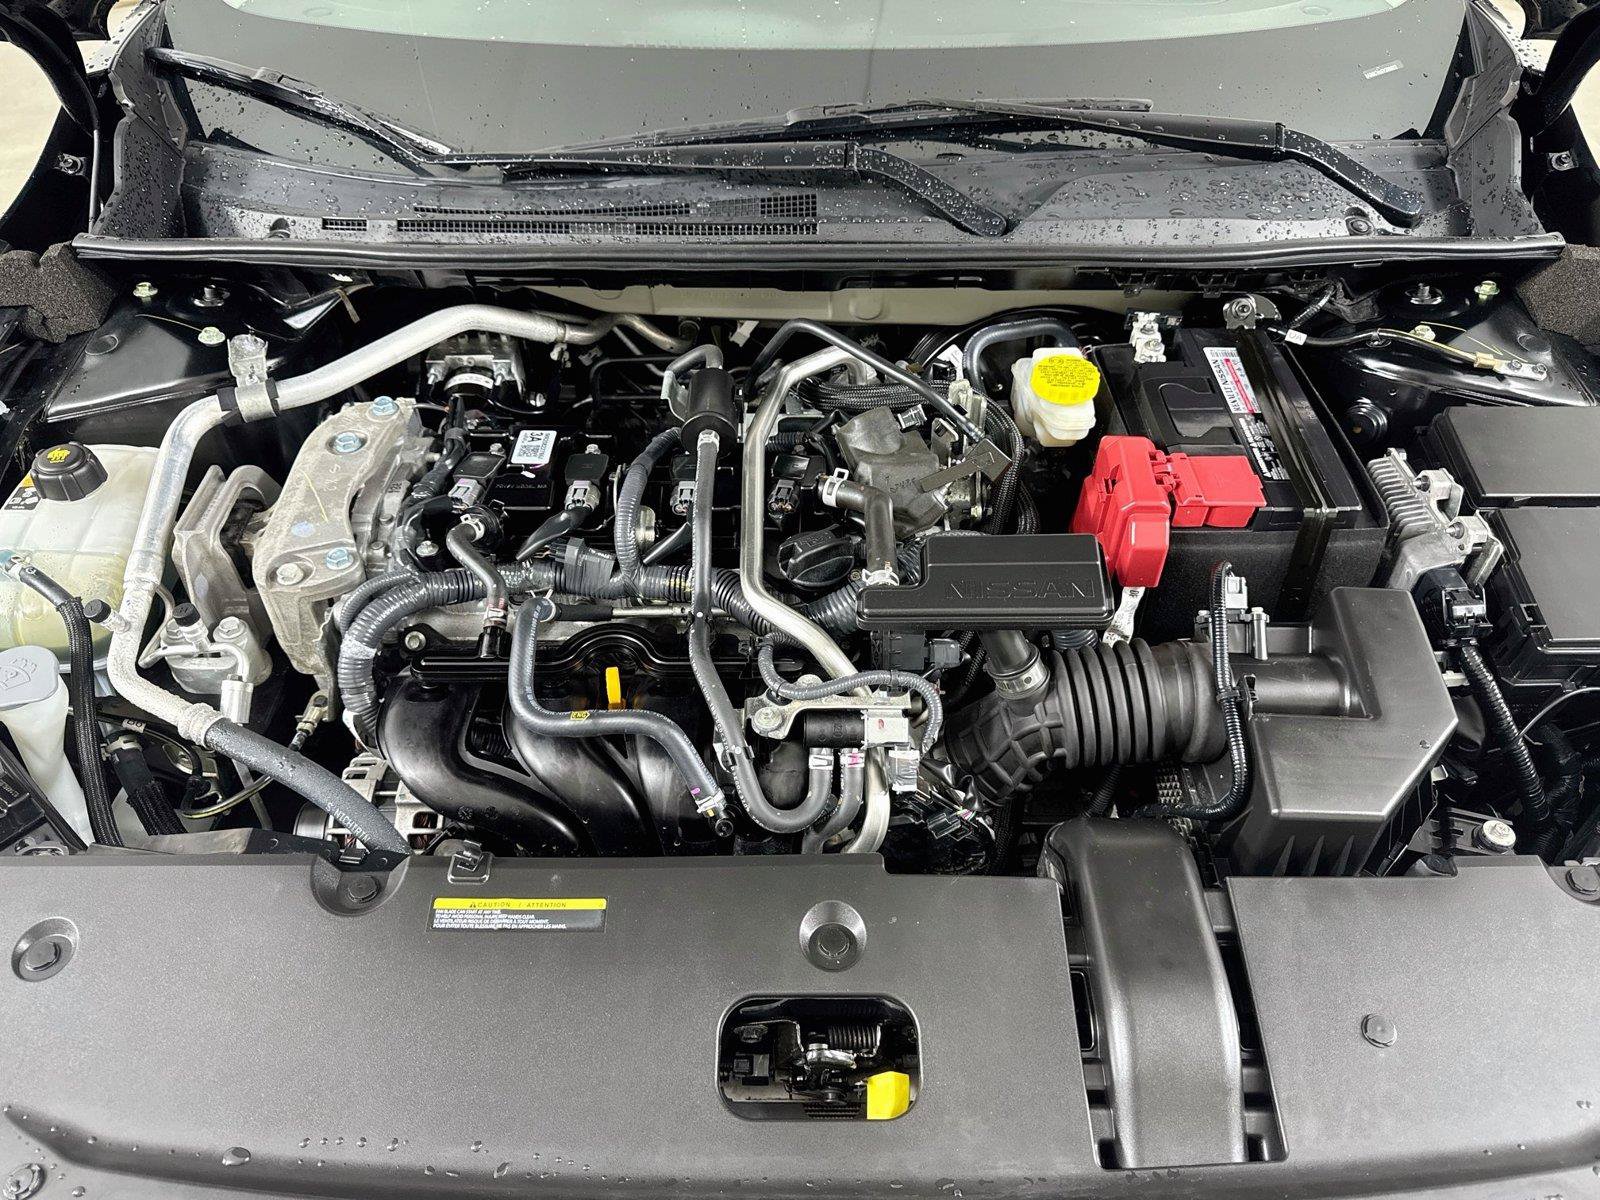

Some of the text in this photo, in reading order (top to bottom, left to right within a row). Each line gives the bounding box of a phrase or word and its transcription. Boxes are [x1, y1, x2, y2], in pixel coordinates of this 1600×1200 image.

[1211, 359, 1229, 386] NISSAN
[528, 431, 544, 443] 3A
[946, 578, 1096, 599] NISSAN
